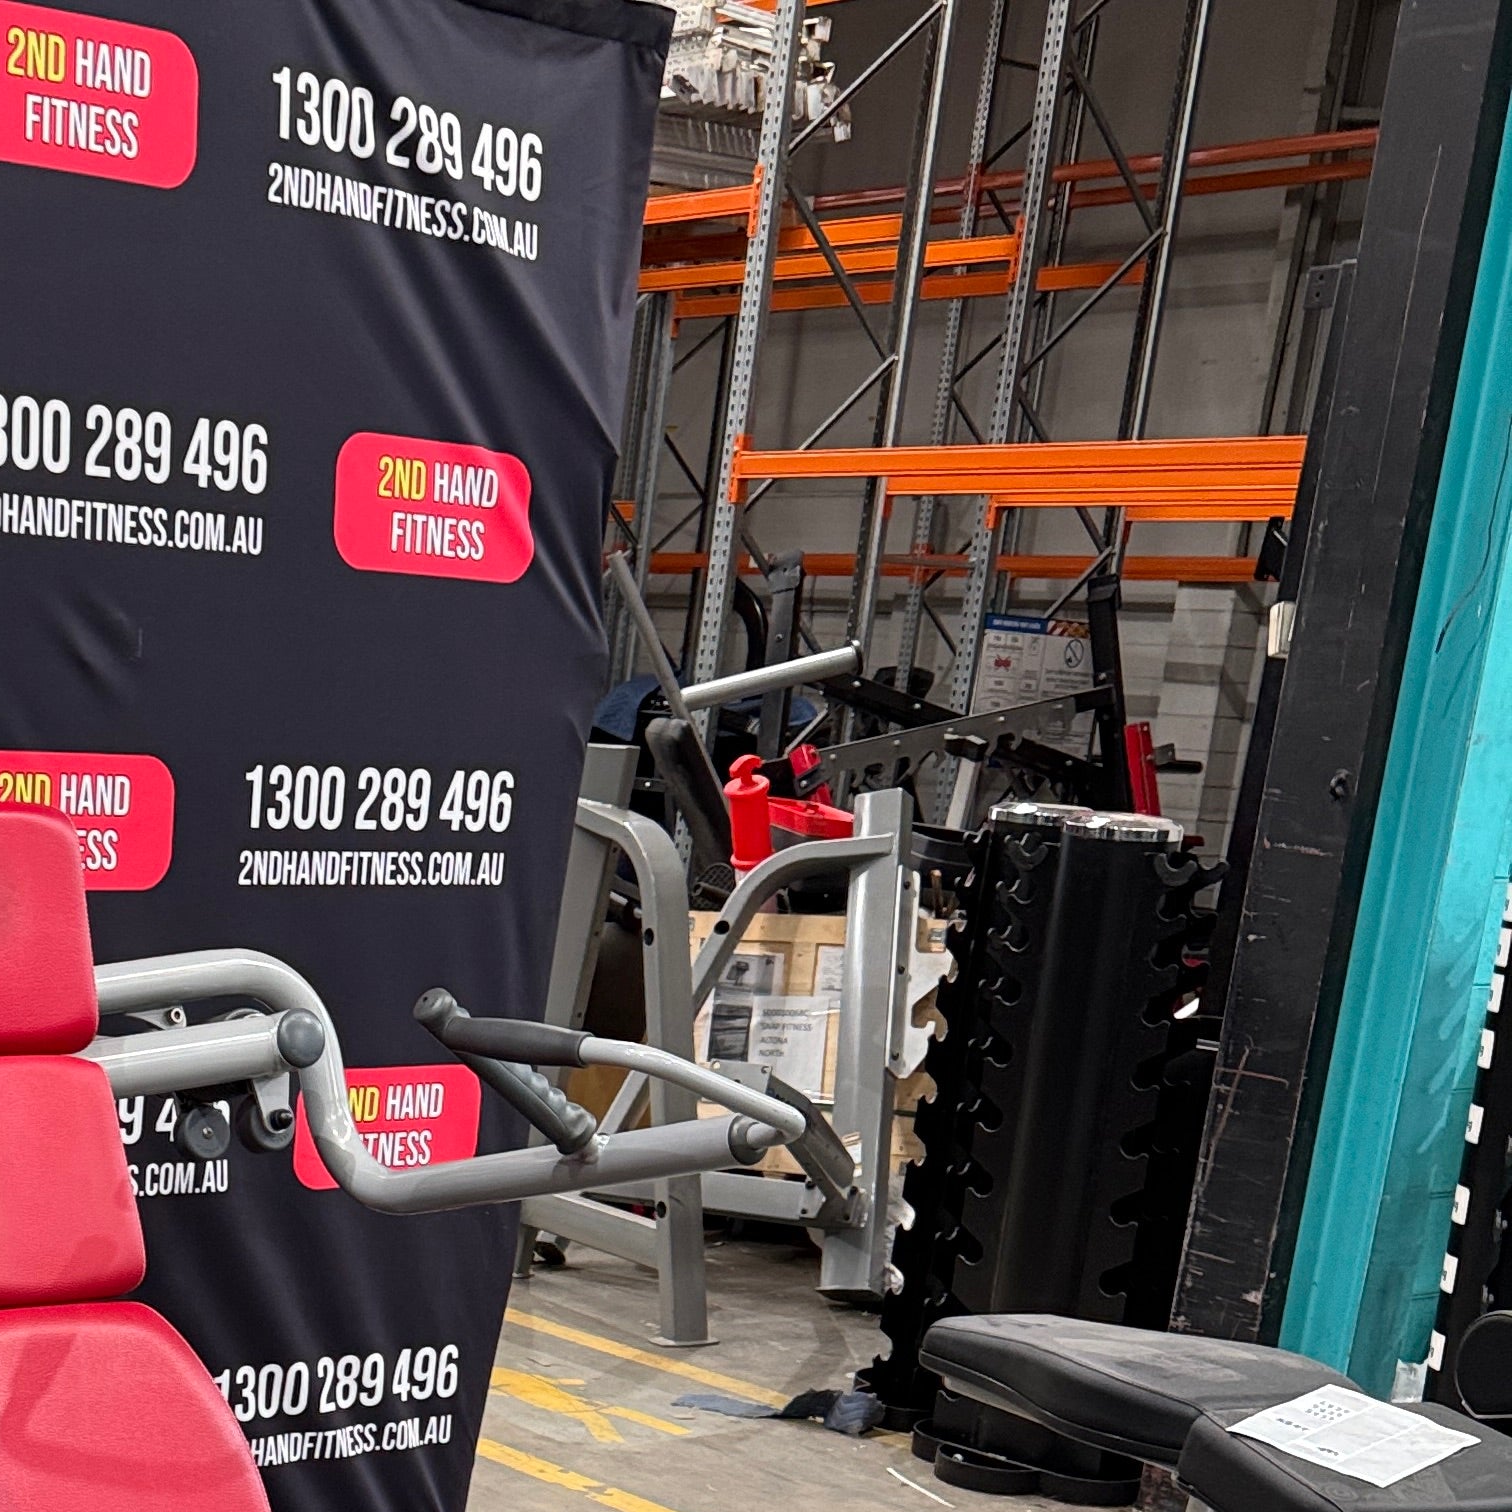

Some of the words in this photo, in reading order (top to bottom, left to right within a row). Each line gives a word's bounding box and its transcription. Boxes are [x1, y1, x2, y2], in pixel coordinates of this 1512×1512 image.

[7, 27, 66, 82] 2ND
[75, 38, 151, 98] HAND
[25, 93, 139, 159] FITNESS
[272, 66, 376, 159] 1300
[385, 95, 464, 181] 289
[471, 122, 543, 202] 496
[267, 162, 539, 261] 2NDHANDFITNESS.COM.AU
[84, 404, 172, 485] 289
[183, 417, 269, 495] 496
[378, 456, 427, 501] 2ND
[433, 462, 499, 508] HAND
[391, 511, 485, 561] FITNESS
[59, 773, 131, 816] HAND
[245, 764, 346, 831] 1300
[354, 766, 432, 832] 289
[438, 769, 515, 833] 496
[237, 849, 505, 886] 2NDHANDFITNESS.COM.AU
[347, 1086, 380, 1122] ND
[385, 1083, 445, 1121] HAND
[316, 1352, 385, 1414] 289
[391, 1344, 459, 1402] 496
